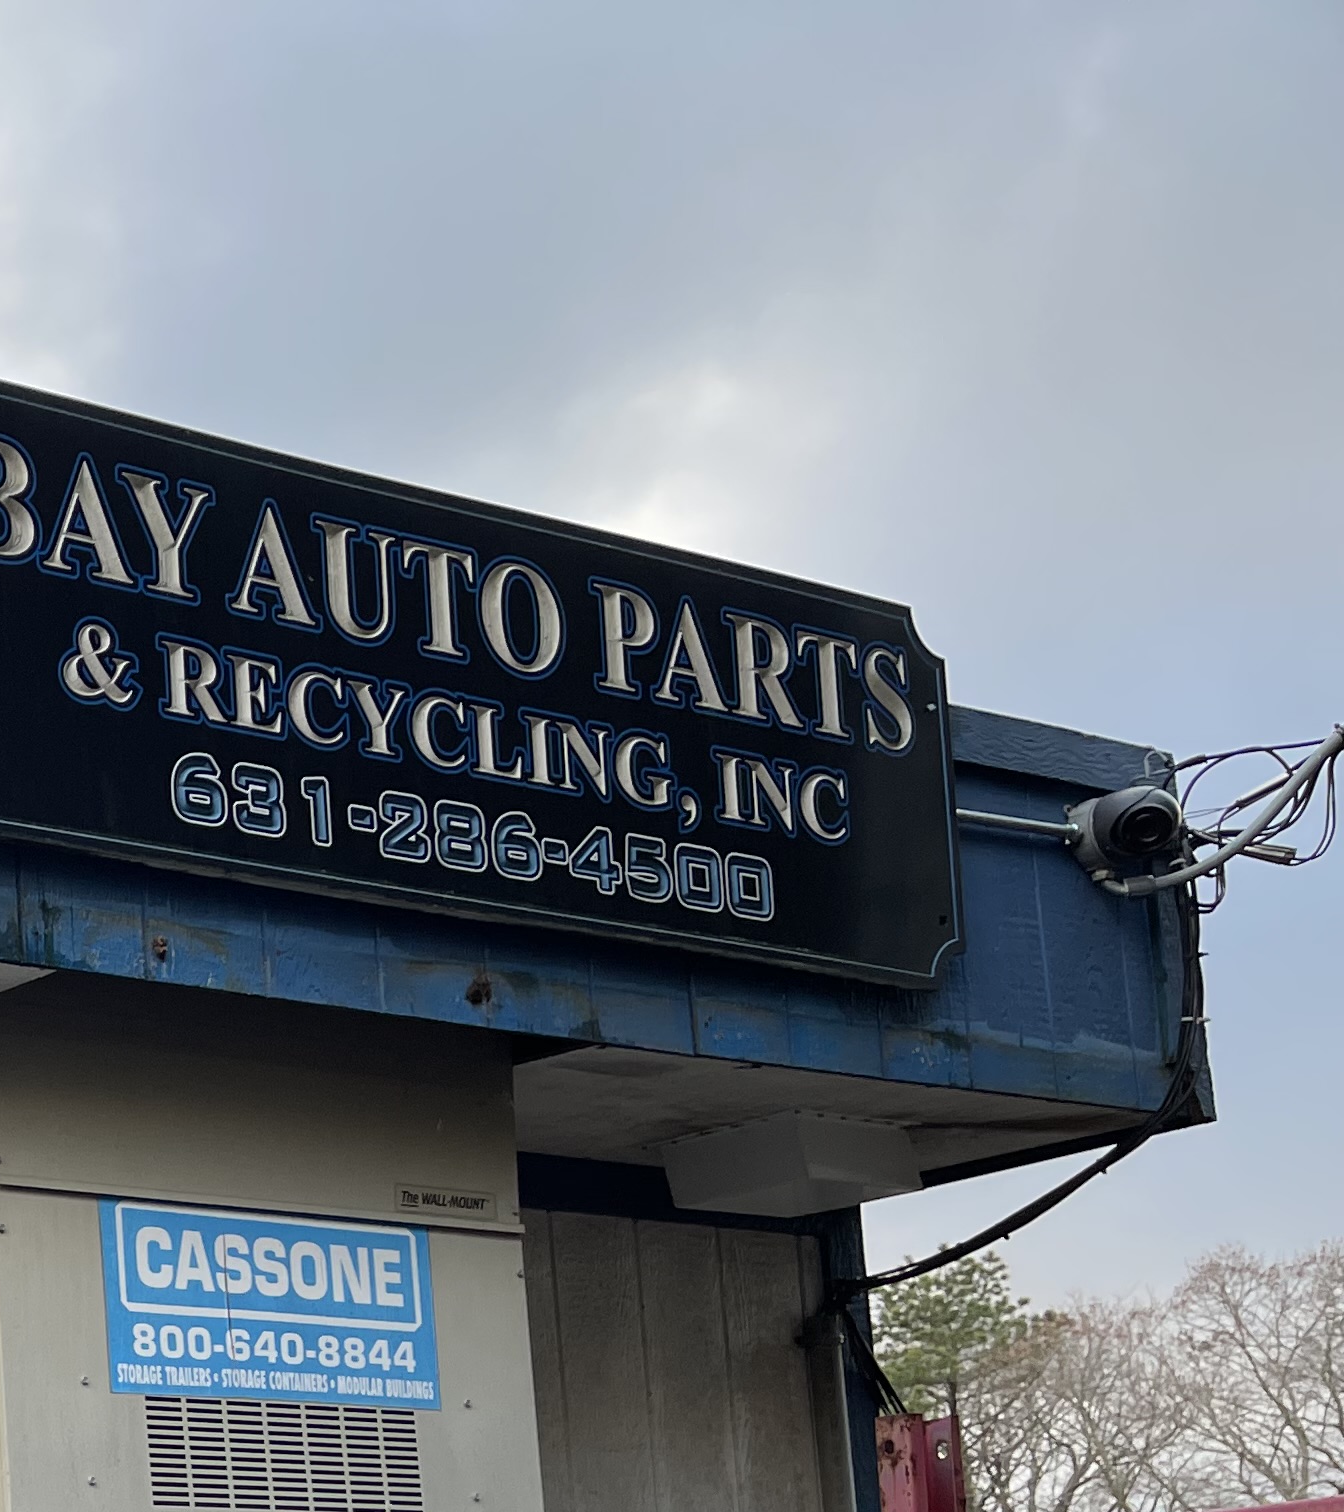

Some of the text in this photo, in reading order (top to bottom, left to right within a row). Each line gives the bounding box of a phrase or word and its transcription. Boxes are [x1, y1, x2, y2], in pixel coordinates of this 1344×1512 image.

[230, 505, 561, 674] AUTO
[592, 582, 914, 752] PARTS
[61, 622, 848, 841] & RECYCLING, INC
[170, 751, 776, 922] 631-286-4500
[401, 1190, 419, 1205] The
[134, 1225, 406, 1309] CASSONE
[117, 1362, 434, 1401] STORAGE TRAILERS STORAGE CONTAINERS MODULAR BUILDINGS
[131, 1321, 418, 1374] 800-640-8844
